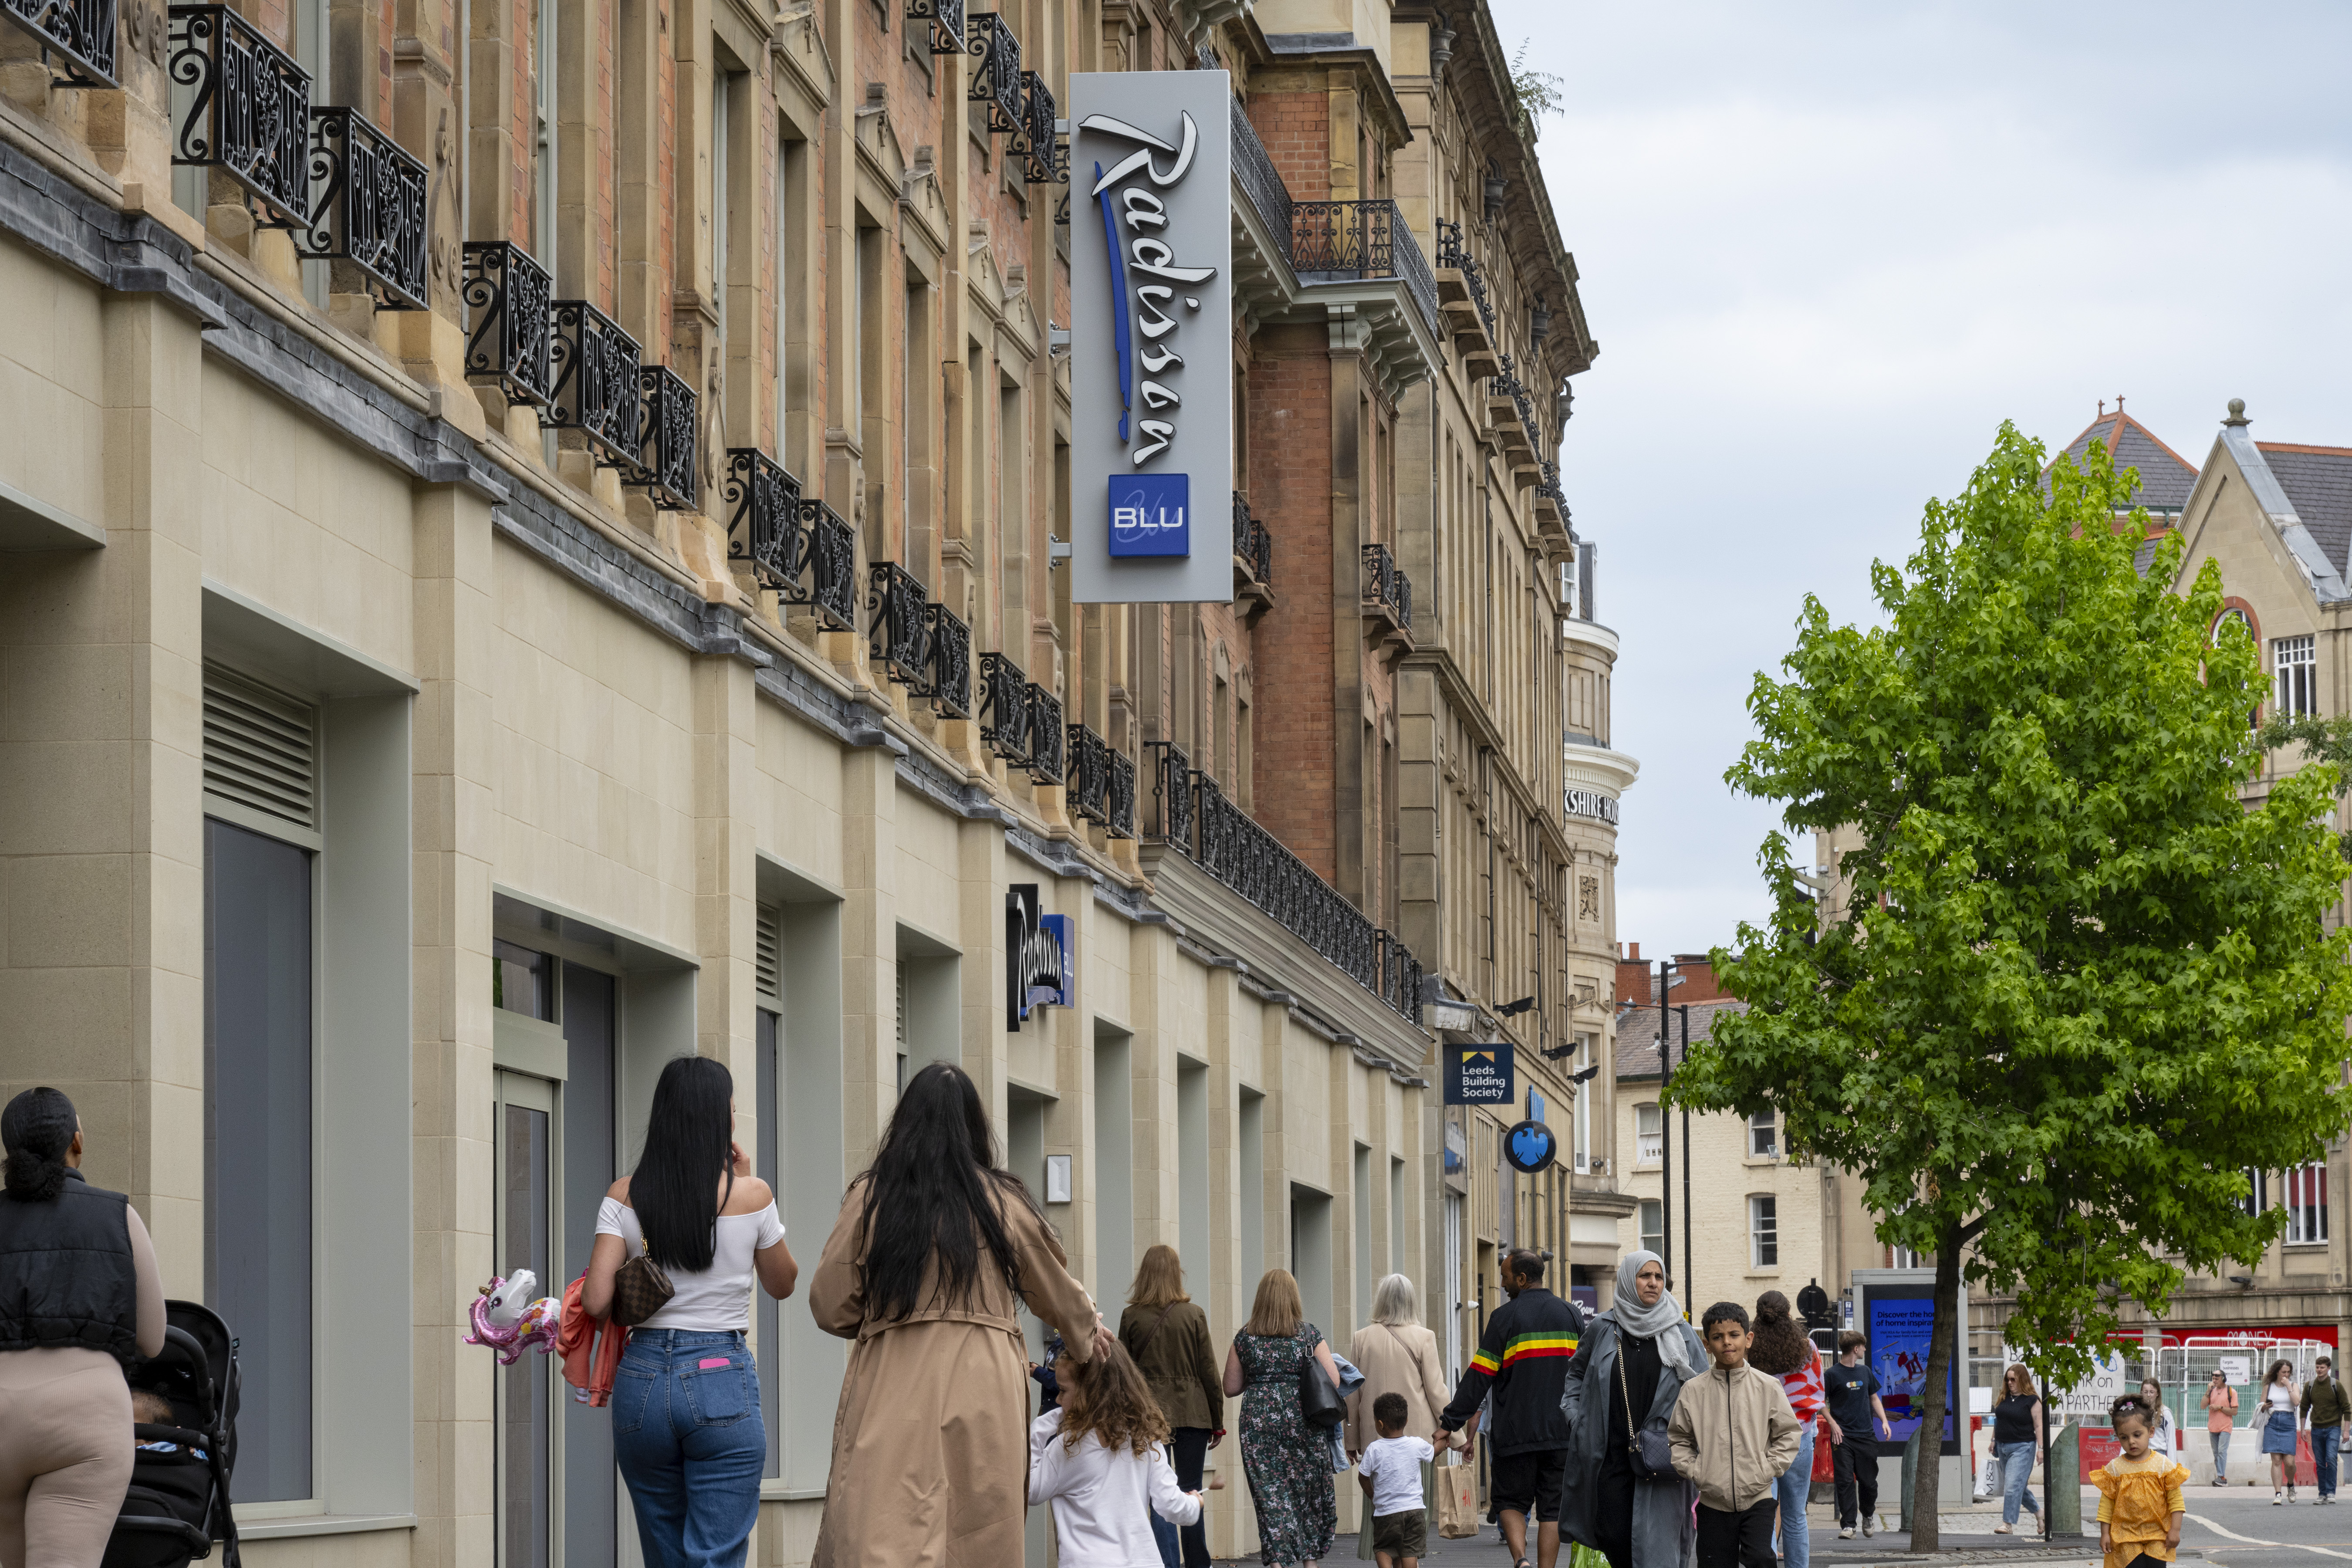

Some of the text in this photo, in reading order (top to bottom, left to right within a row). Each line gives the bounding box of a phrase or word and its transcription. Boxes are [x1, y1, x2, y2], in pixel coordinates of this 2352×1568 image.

[1078, 110, 1218, 469] Radisson
[1113, 506, 1184, 529] BLU
[1463, 1065, 1495, 1075] Leeds
[1463, 1076, 1505, 1088] Building
[1463, 1087, 1504, 1098] Society
[1908, 1319, 1933, 1328] inspirat
[2098, 1377, 2112, 1388] on
[2056, 1394, 2118, 1411] APARTHE
